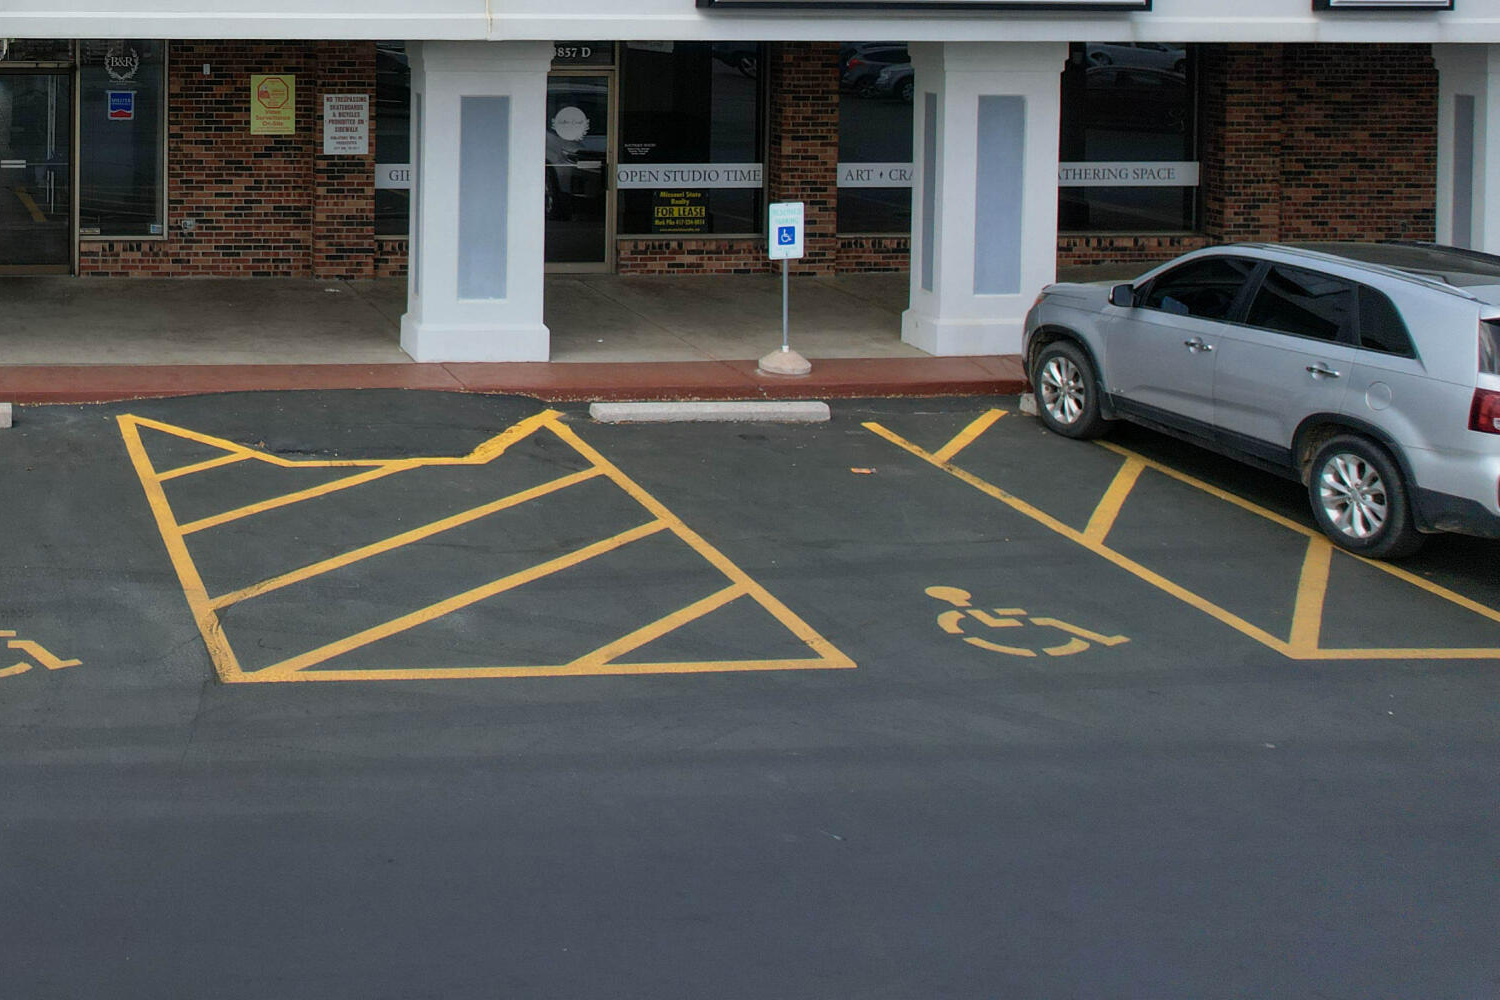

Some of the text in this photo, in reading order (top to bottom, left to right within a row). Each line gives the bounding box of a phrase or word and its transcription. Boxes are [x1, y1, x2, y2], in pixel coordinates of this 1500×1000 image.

[554, 47, 591, 58] 857 D
[111, 56, 133, 67] B&R
[617, 169, 762, 183] OPEN STUDIO TIME
[845, 169, 874, 182] ART
[1058, 167, 1176, 181] THERING SPACE
[656, 207, 704, 217] FOR LEASE
